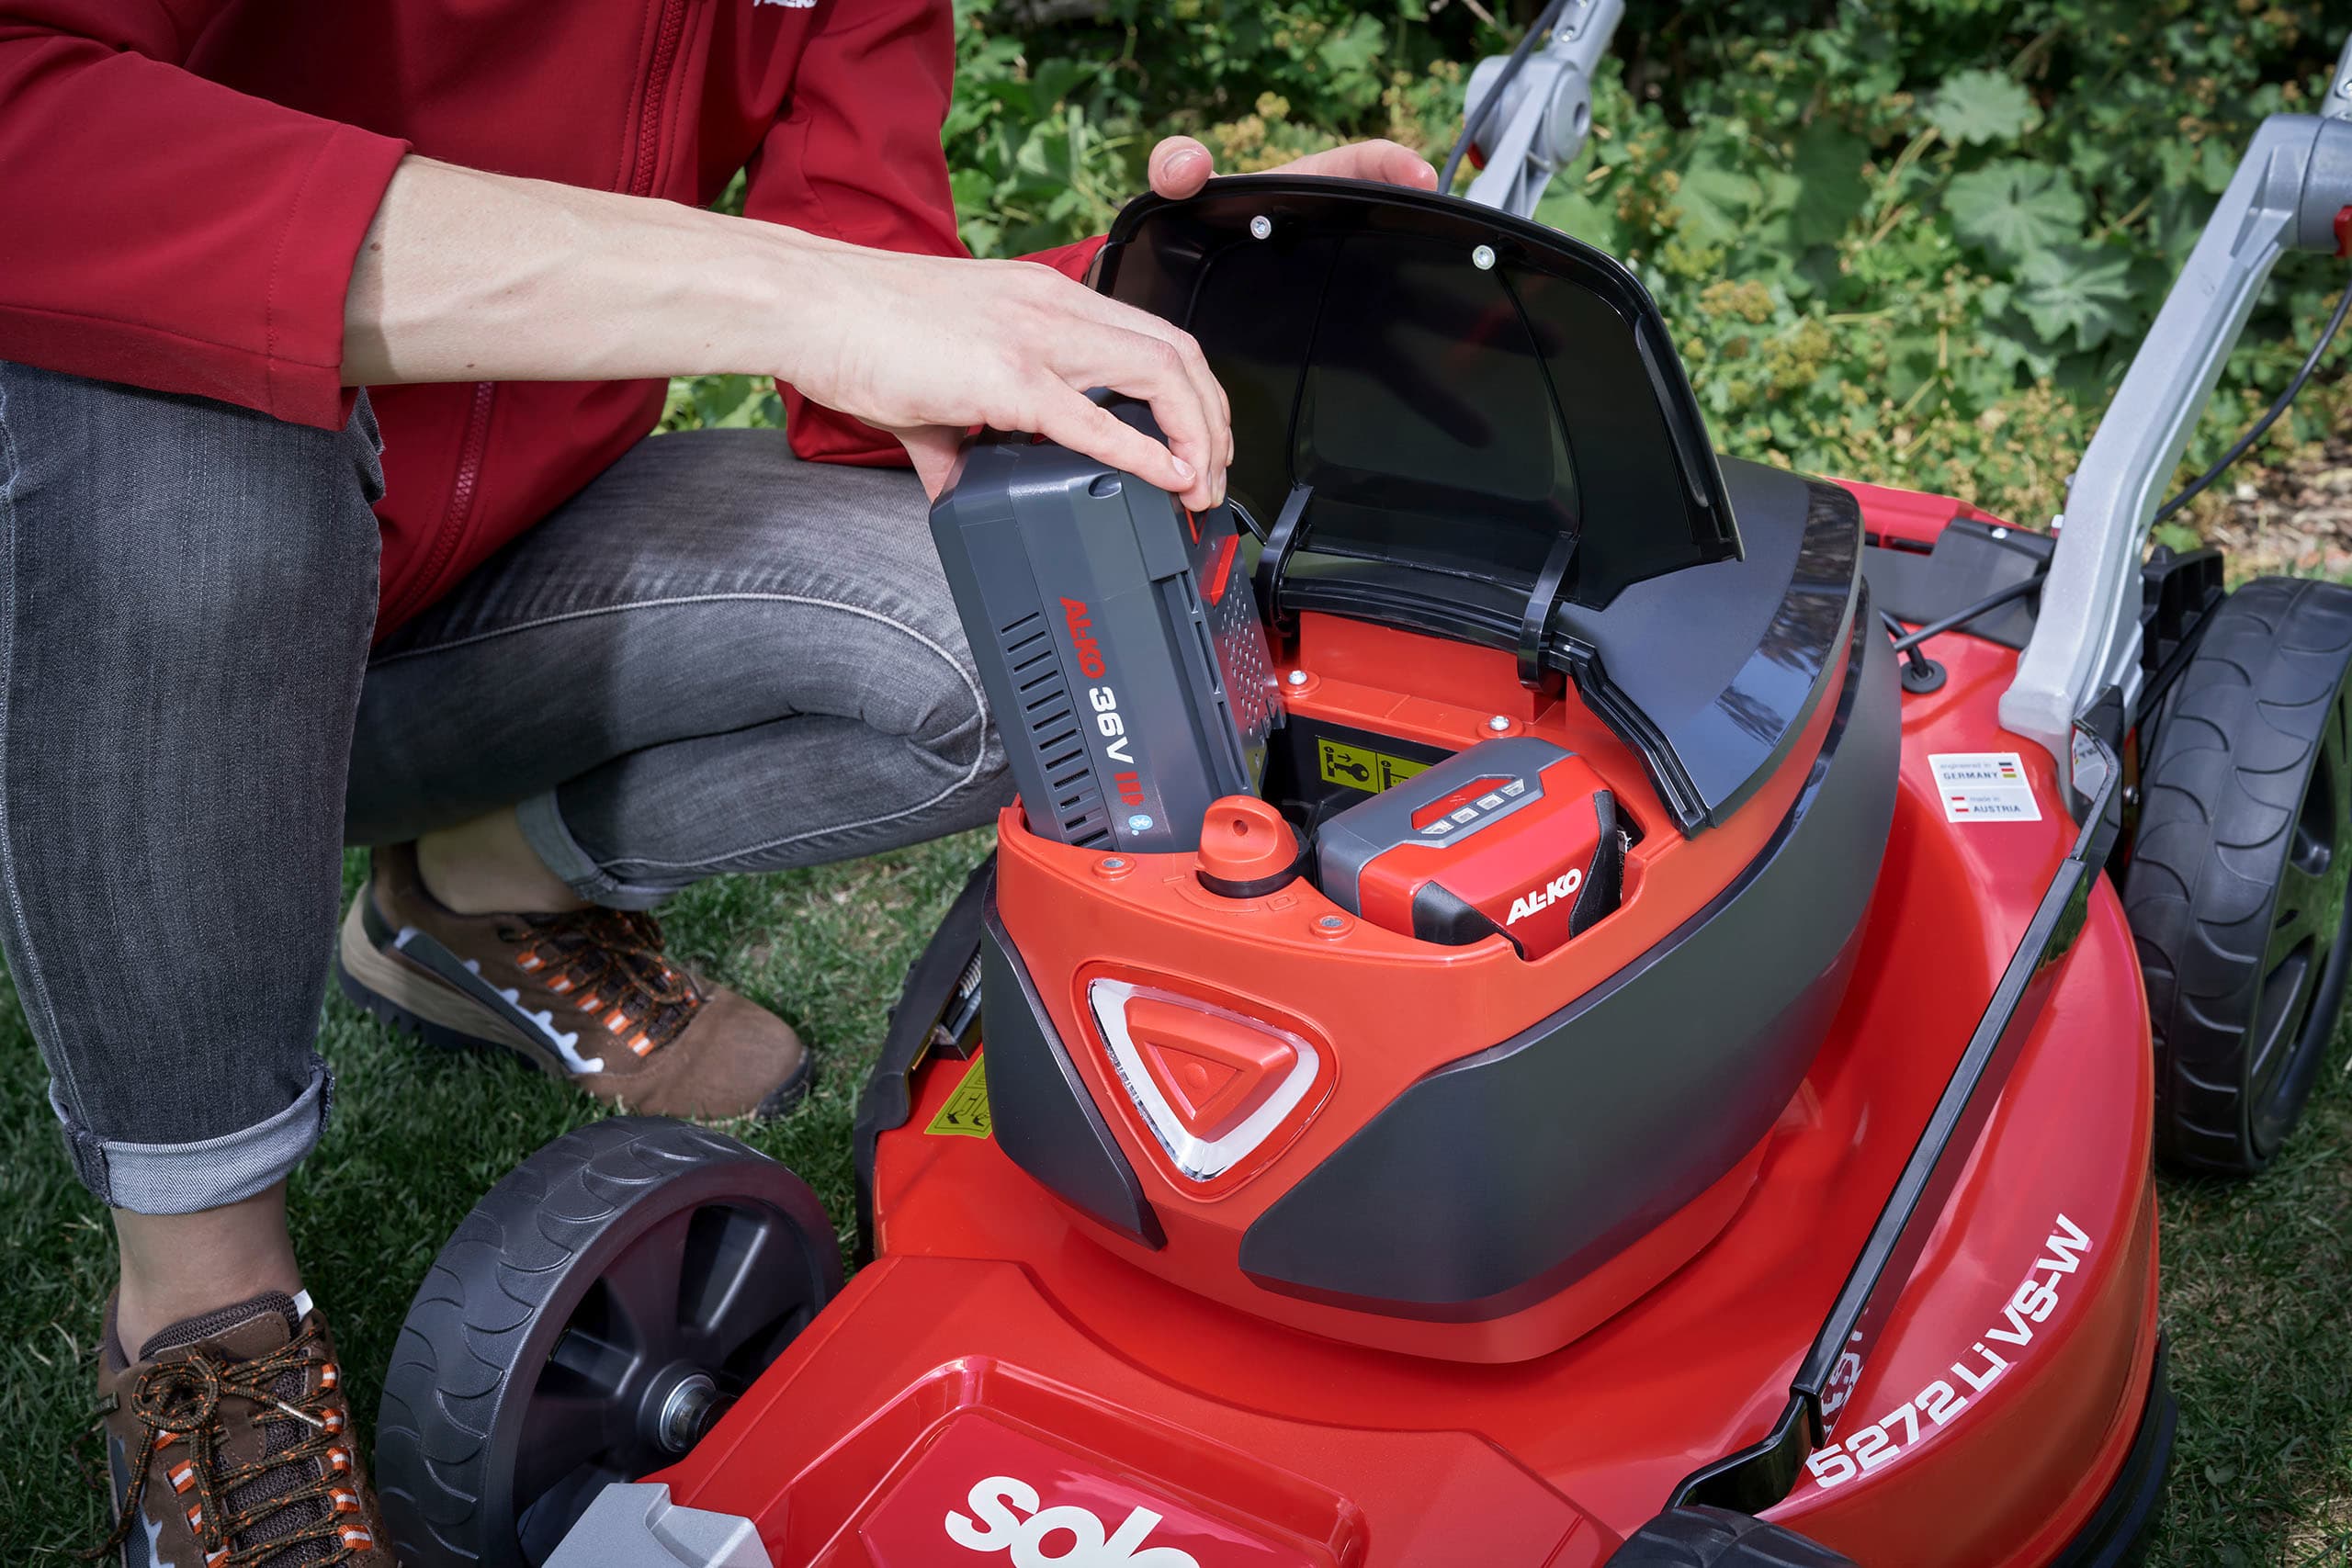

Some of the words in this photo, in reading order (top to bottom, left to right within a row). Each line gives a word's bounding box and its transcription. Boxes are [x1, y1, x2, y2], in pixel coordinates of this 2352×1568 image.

[1060, 597, 1105, 679] AL-KO
[1089, 686, 1135, 764] 36V
[1973, 805, 2021, 813] AUSTRIA
[1507, 869, 1581, 926] AL-KO
[1805, 1379, 1970, 1489] 5272
[1950, 1341, 2009, 1393] Li
[1985, 1213, 2090, 1346] VS-W
[944, 1475, 1201, 1568] sol
